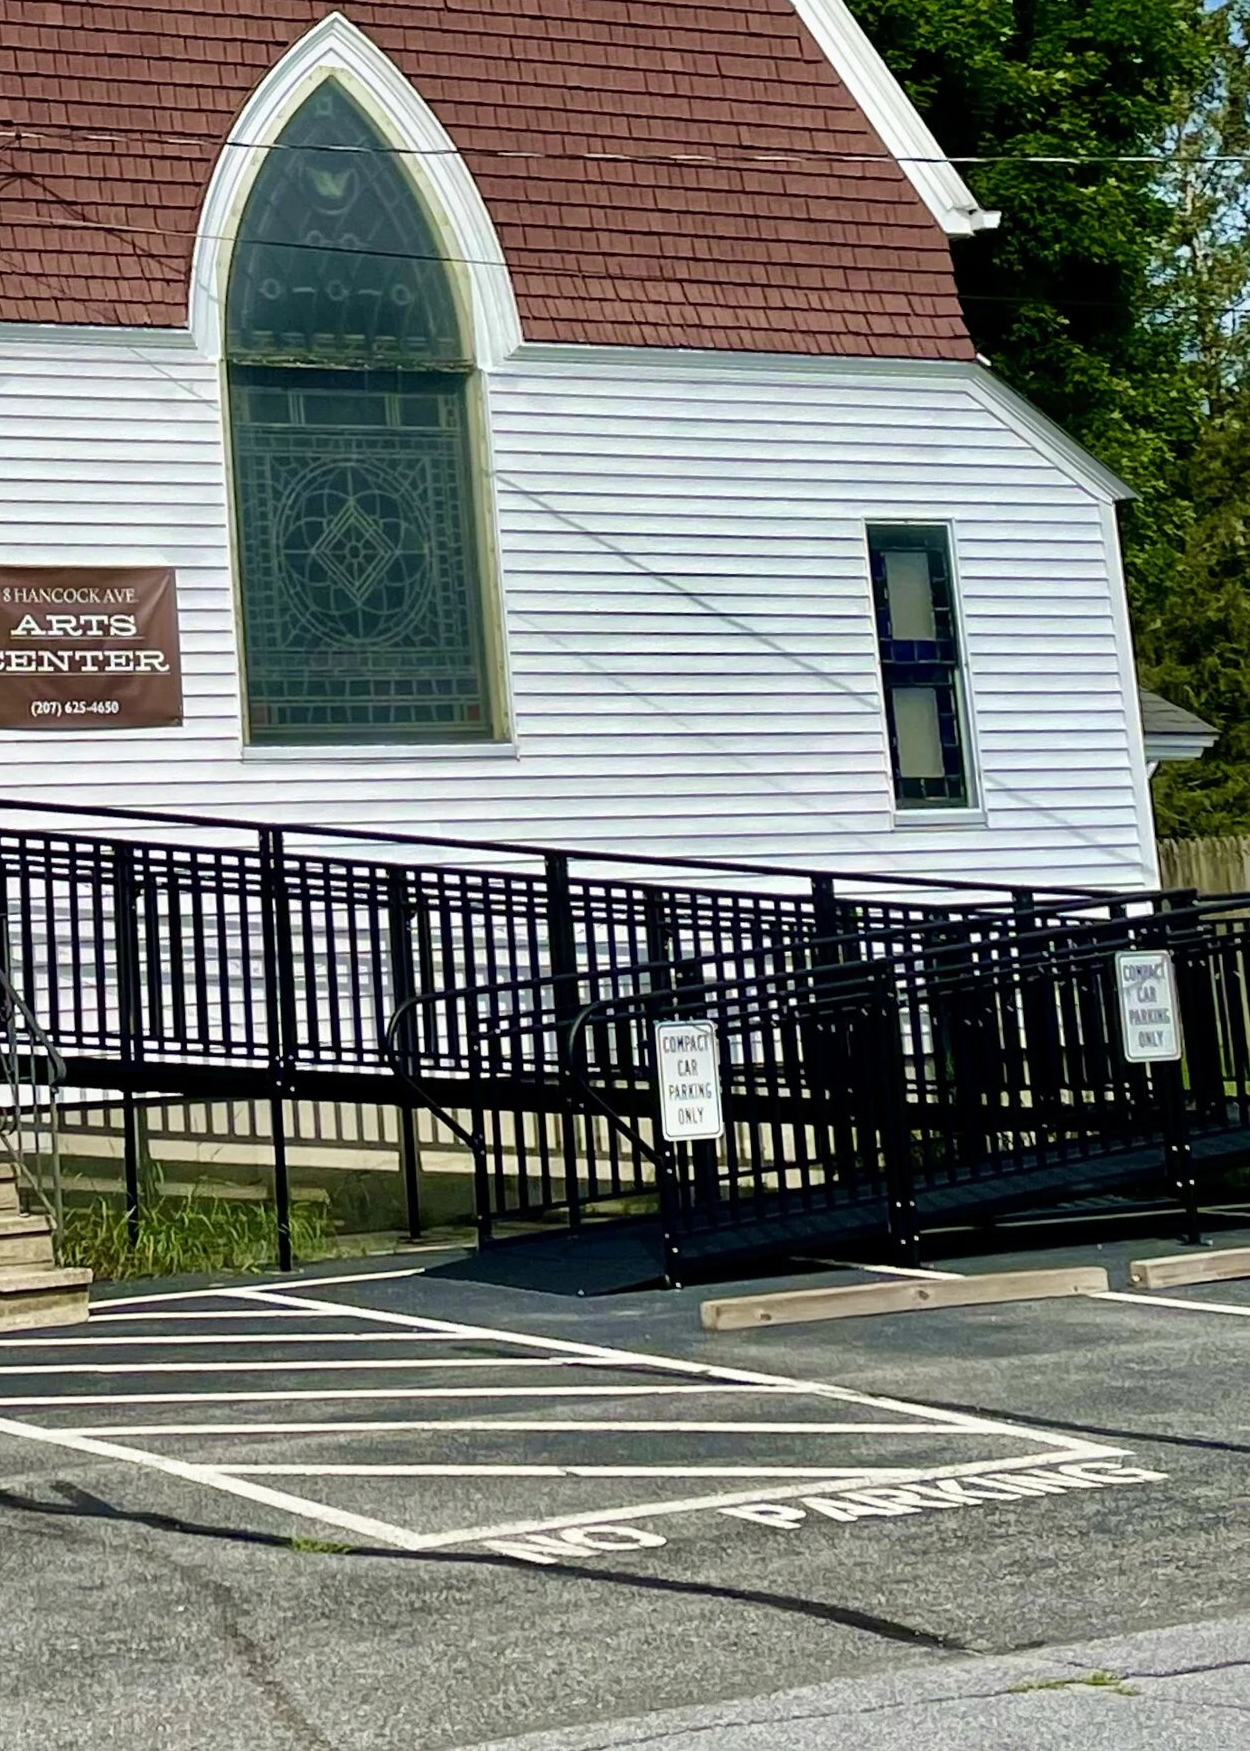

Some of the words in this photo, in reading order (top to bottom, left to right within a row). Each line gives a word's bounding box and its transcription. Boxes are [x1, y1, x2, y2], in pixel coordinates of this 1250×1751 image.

[2, 587, 12, 603] 8
[14, 587, 101, 604] HANCOCK
[10, 614, 138, 636] ARTS
[31, 700, 62, 717] (207)
[64, 700, 119, 714] 625-4650
[1137, 986, 1157, 1003] CAR
[1129, 1007, 1171, 1026] PARKING
[662, 1034, 709, 1054] COMPACT
[1138, 1030, 1164, 1048] ONLY
[677, 1059, 699, 1077] CAR
[668, 1081, 712, 1101] PARKING
[677, 1107, 704, 1125] ONLY
[478, 1524, 668, 1564] NO
[718, 1461, 1170, 1530] PARKING
